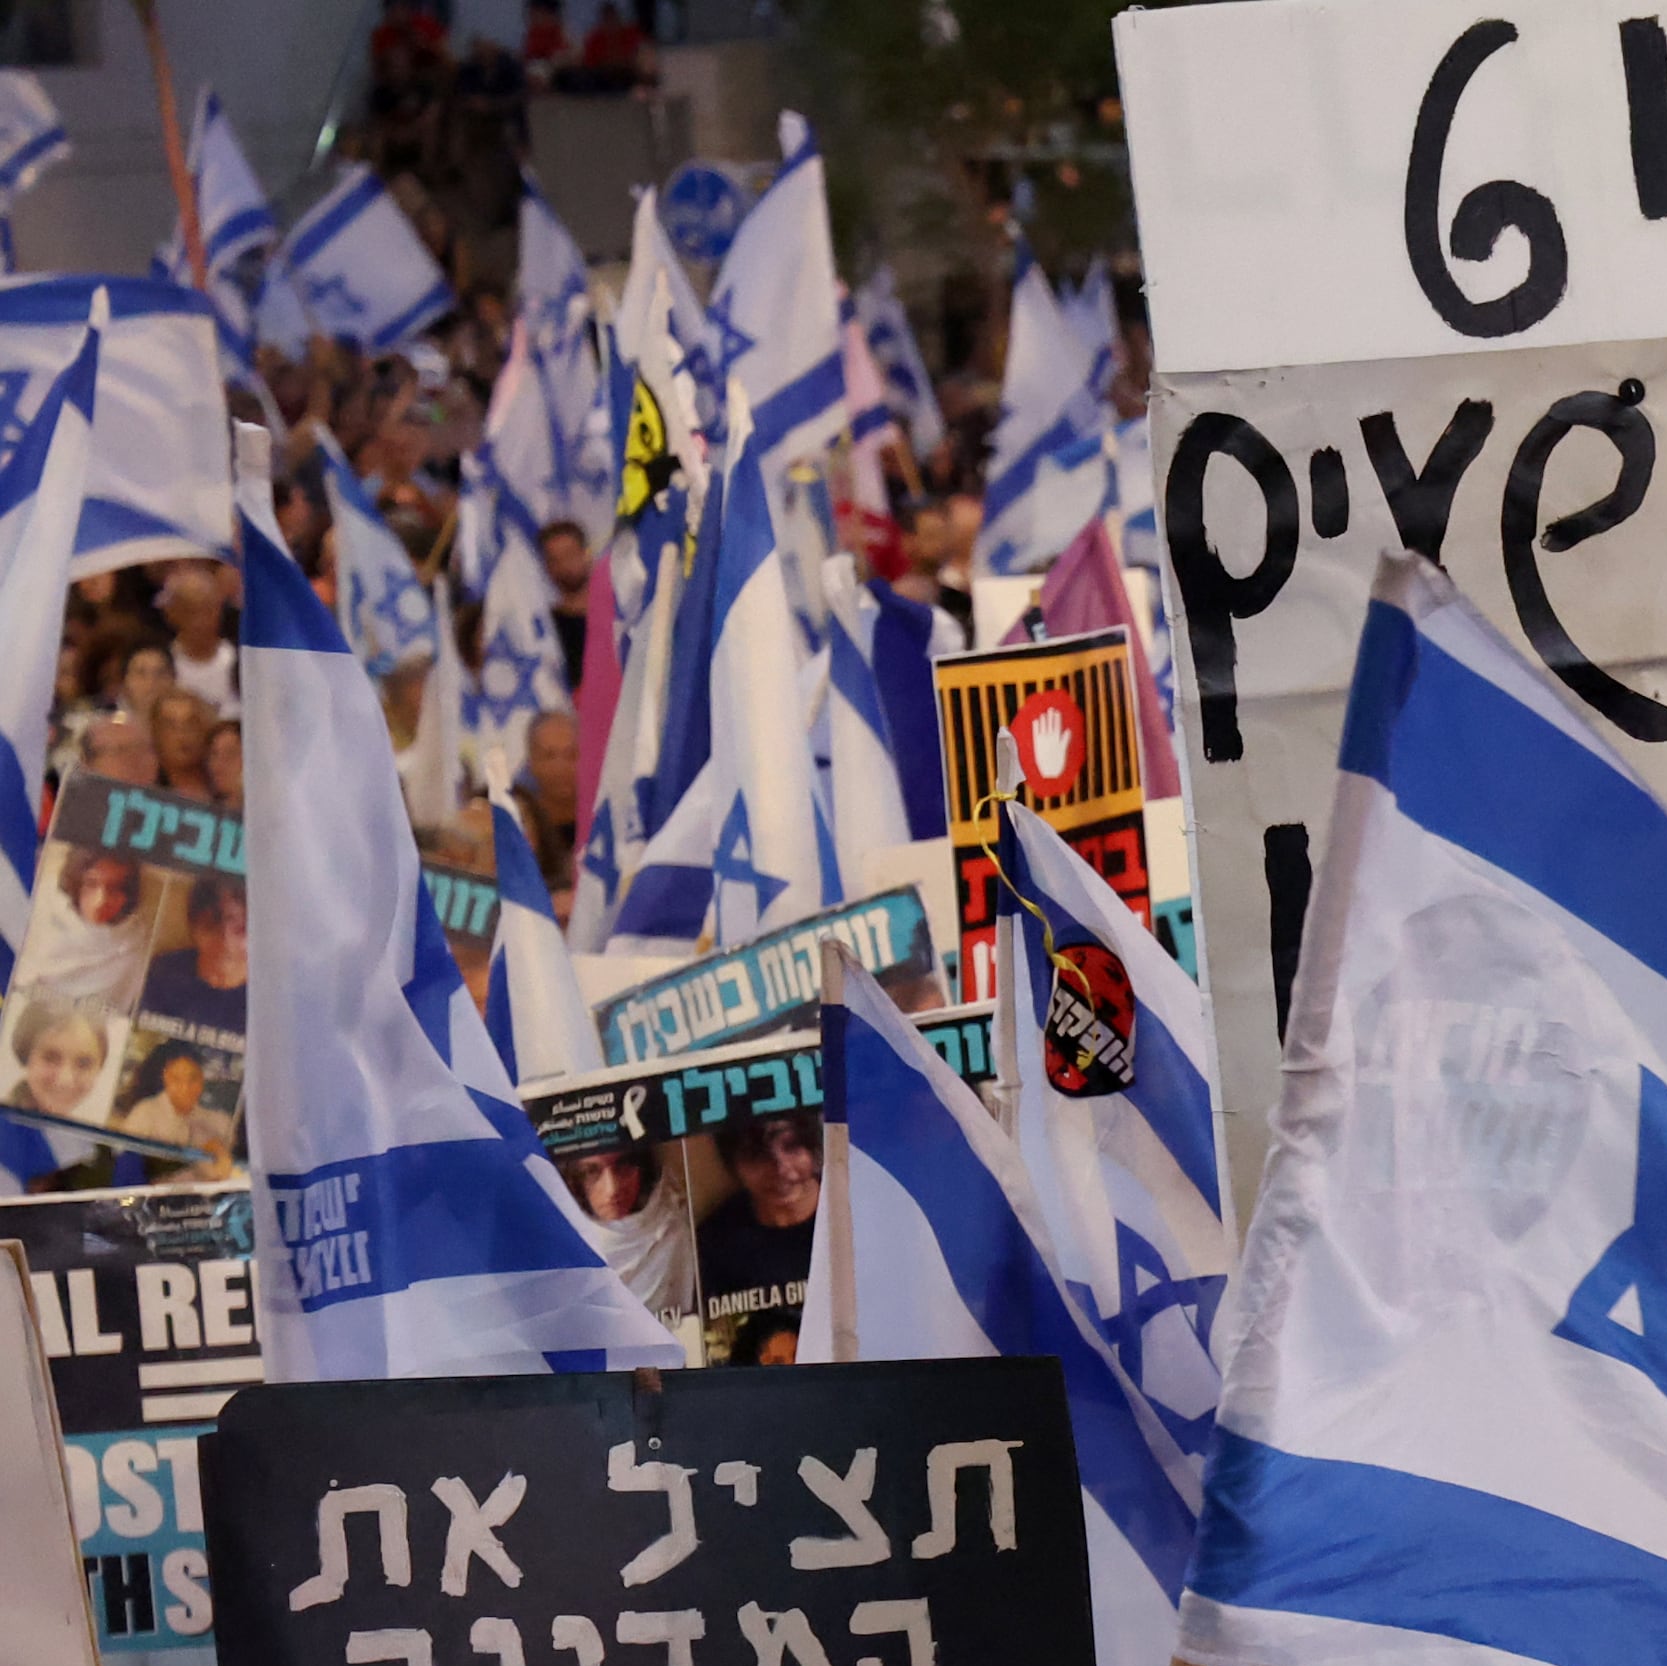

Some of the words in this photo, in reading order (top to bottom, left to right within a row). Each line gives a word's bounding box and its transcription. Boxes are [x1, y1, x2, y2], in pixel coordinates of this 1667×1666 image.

[135, 1260, 262, 1350] RE
[708, 1284, 783, 1321] DANIELA
[288, 1468, 528, 1612] את
[607, 1438, 1024, 1588] תציל
